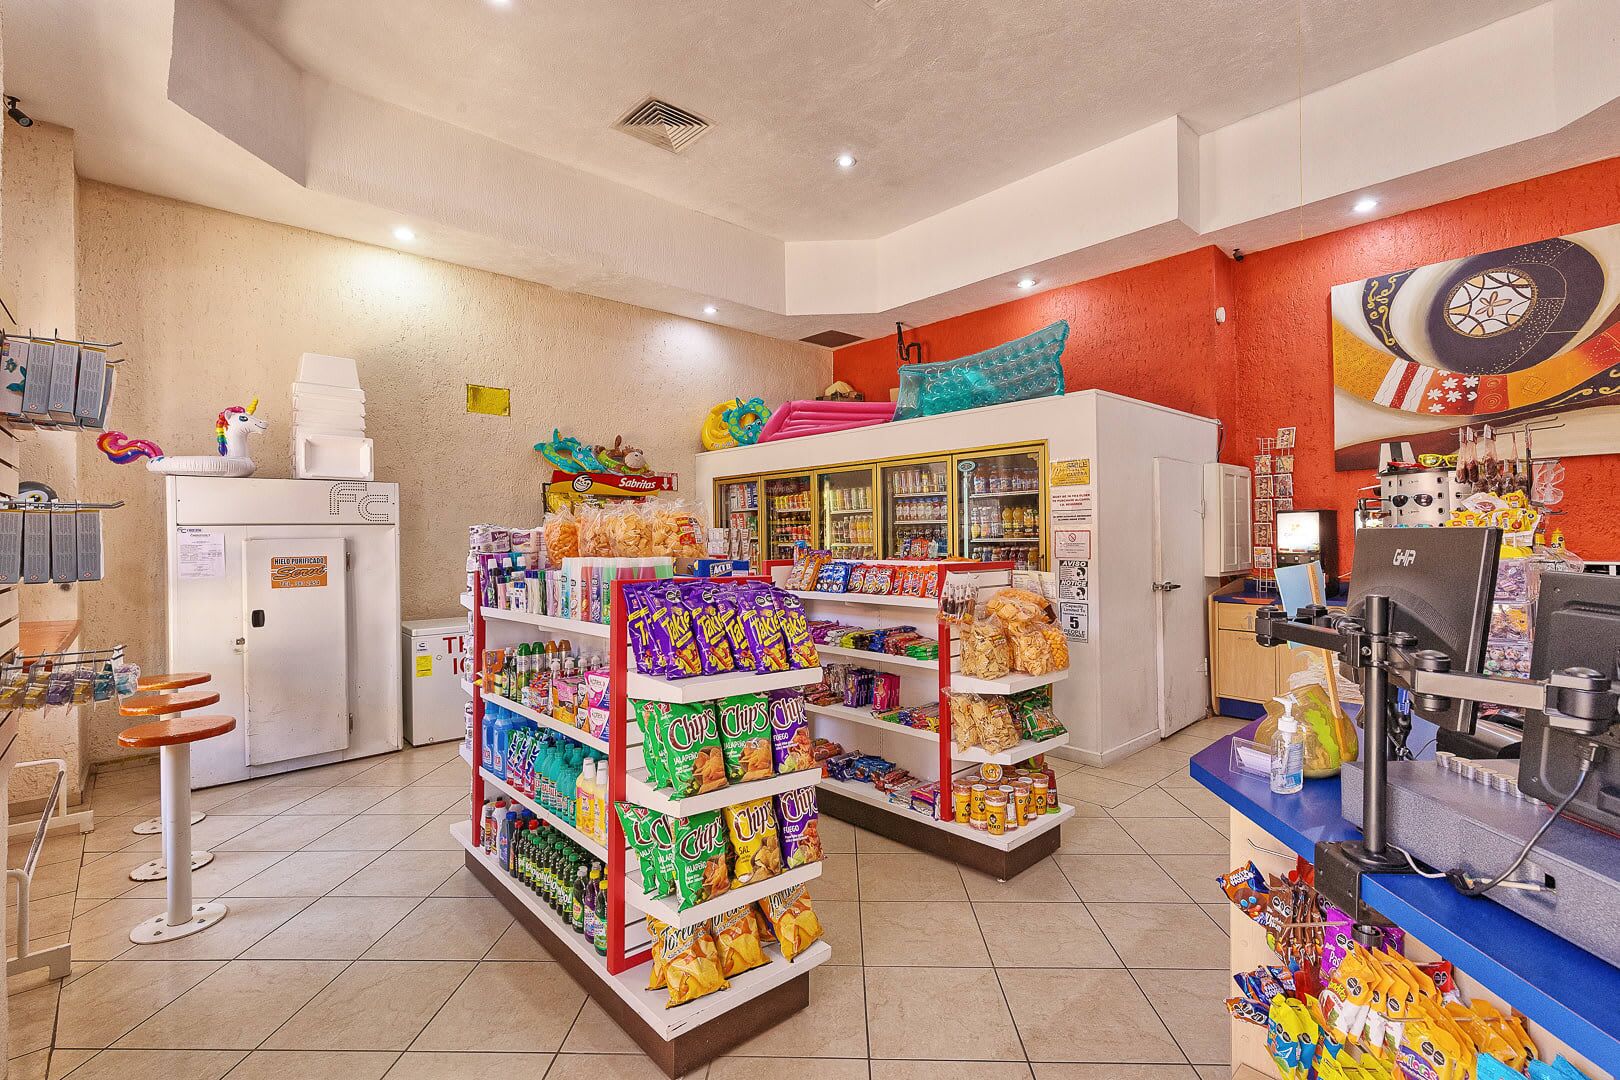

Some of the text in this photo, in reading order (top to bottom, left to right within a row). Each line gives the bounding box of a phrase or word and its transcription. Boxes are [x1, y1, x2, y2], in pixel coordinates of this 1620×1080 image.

[618, 477, 657, 489] Sabritas
[291, 557, 324, 565] PURIFICADO
[1069, 616, 1080, 629] 5
[721, 701, 769, 739] Chip's
[773, 732, 789, 742] FUEGO
[783, 824, 800, 834] FUEGO
[738, 845, 751, 855] SAL
